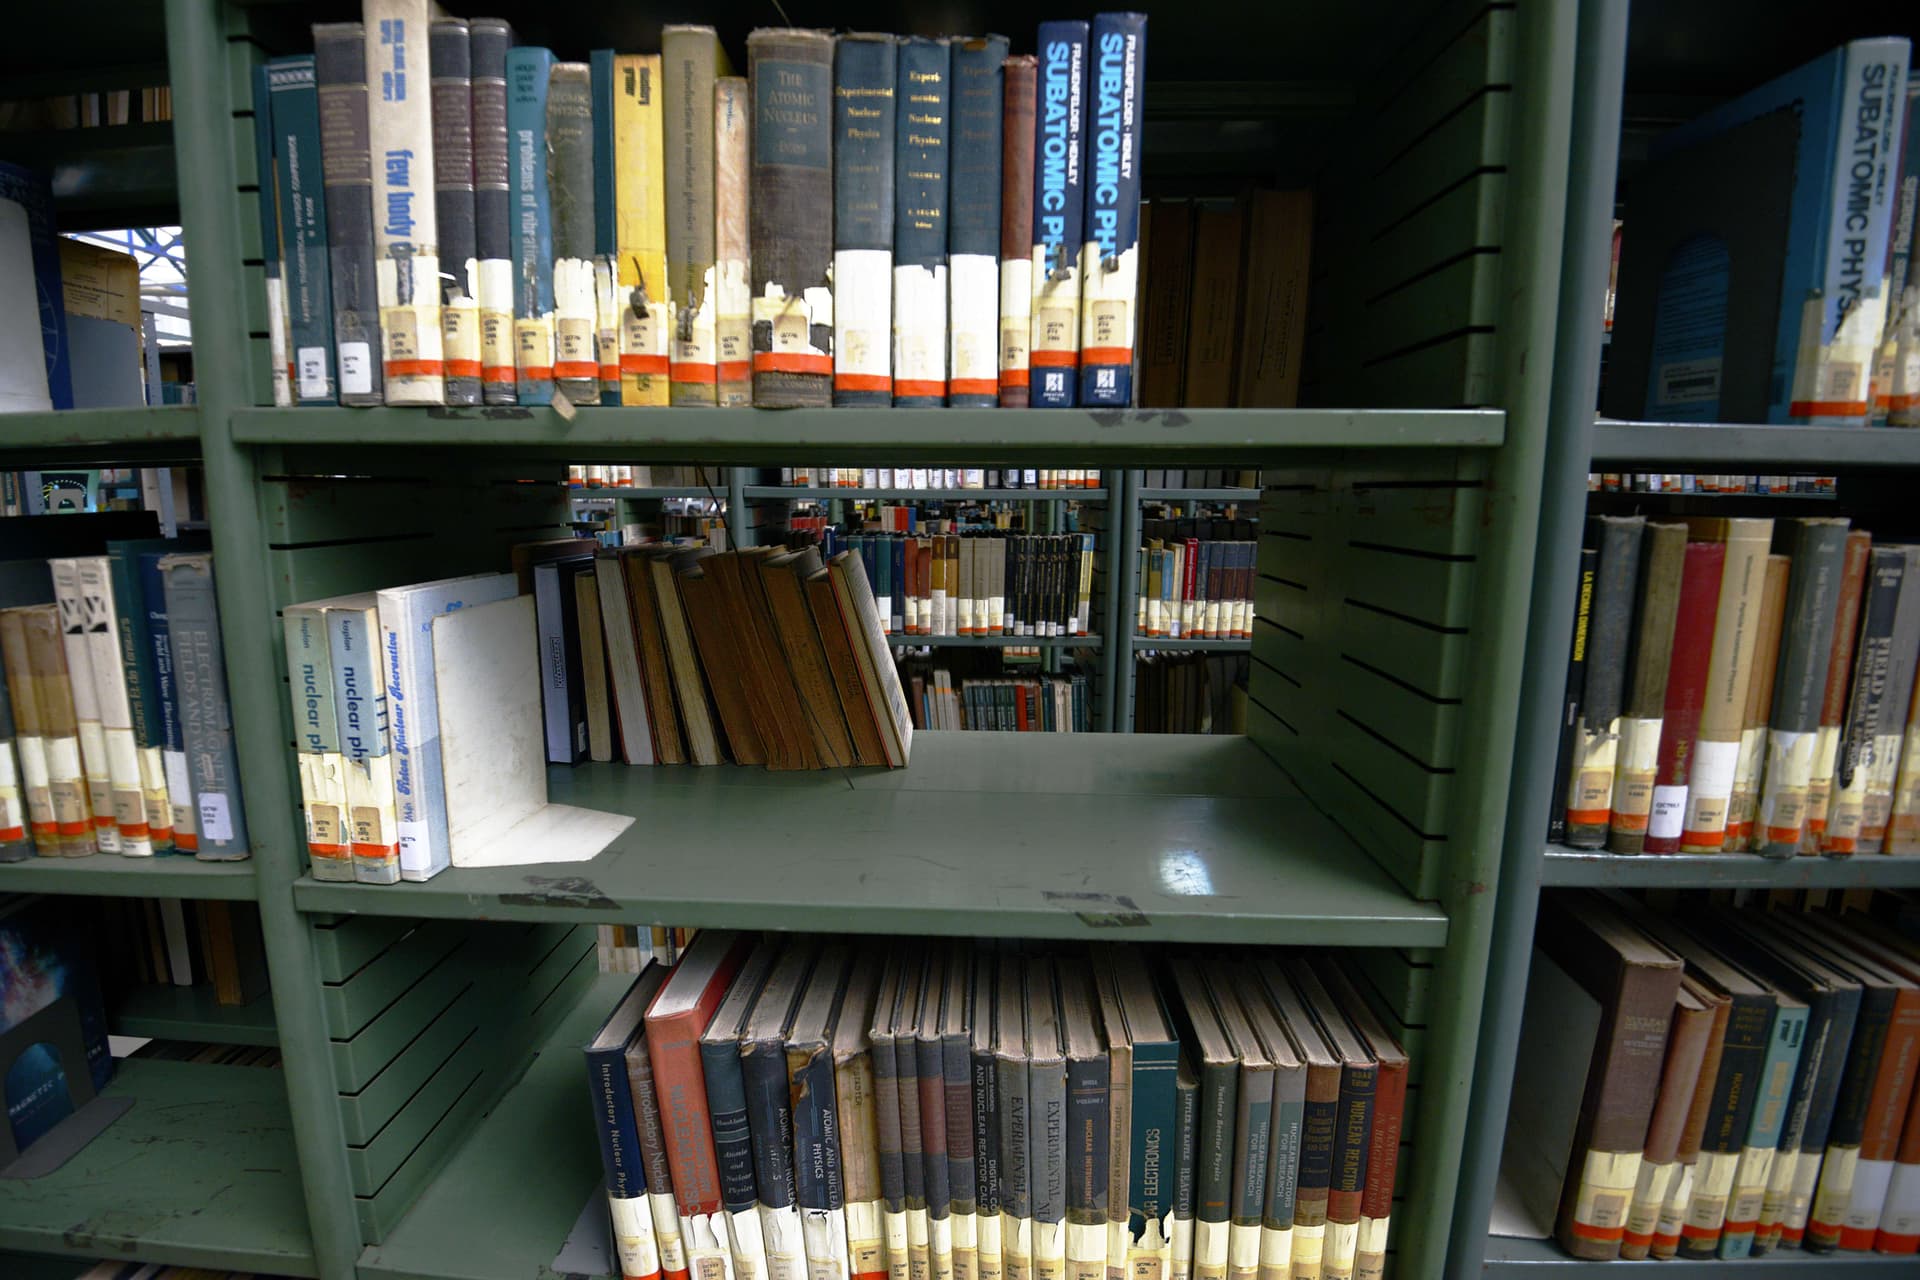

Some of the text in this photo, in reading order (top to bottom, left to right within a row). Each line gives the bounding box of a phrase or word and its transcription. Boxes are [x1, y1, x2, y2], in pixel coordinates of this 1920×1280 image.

[1069, 42, 1081, 133] FRAUENFELDER
[1124, 34, 1137, 126] FRAUENFELDER
[847, 106, 881, 118] Nuclear
[908, 113, 942, 125] Nuclear
[1042, 41, 1069, 211] SUBATOMIC
[1094, 32, 1123, 206] SUBATOMIC
[516, 129, 534, 192] problems
[908, 134, 941, 147] Physics
[1845, 63, 1886, 231] SUBATOMIC
[385, 149, 413, 190] few
[384, 191, 416, 246] body
[520, 195, 536, 207] of
[1574, 571, 1594, 662] LA DECIMA DIMENSION
[178, 630, 196, 693] FIELDS
[303, 664, 323, 727] nuclear
[344, 667, 363, 731] nuclear
[976, 1065, 984, 1086] AND
[601, 1063, 616, 1124] Introductory
[611, 1129, 622, 1168] Nuclear
[638, 1079, 657, 1149] Introductory
[976, 1089, 986, 1135] NUCLEAR
[1218, 1086, 1226, 1118] Nuclear
[1352, 1100, 1367, 1144] NUCLEAR
[822, 1108, 834, 1143] ATOMIC
[1085, 1119, 1093, 1152] NUCLEAR
[1250, 1133, 1258, 1149] FOR
[1257, 1121, 1266, 1160] NUCLEAR
[1289, 1122, 1298, 1162] NUCLEAR
[813, 1143, 824, 1180] PHYSICS
[826, 1147, 836, 1167] AND
[978, 1137, 988, 1183] REACTOR
[1047, 1100, 1060, 1197] EXPERIMENTAL
[1144, 1128, 1161, 1196] ELECTRONICS
[1213, 1153, 1223, 1182] Physics
[988, 1159, 998, 1191] DIGITAL
